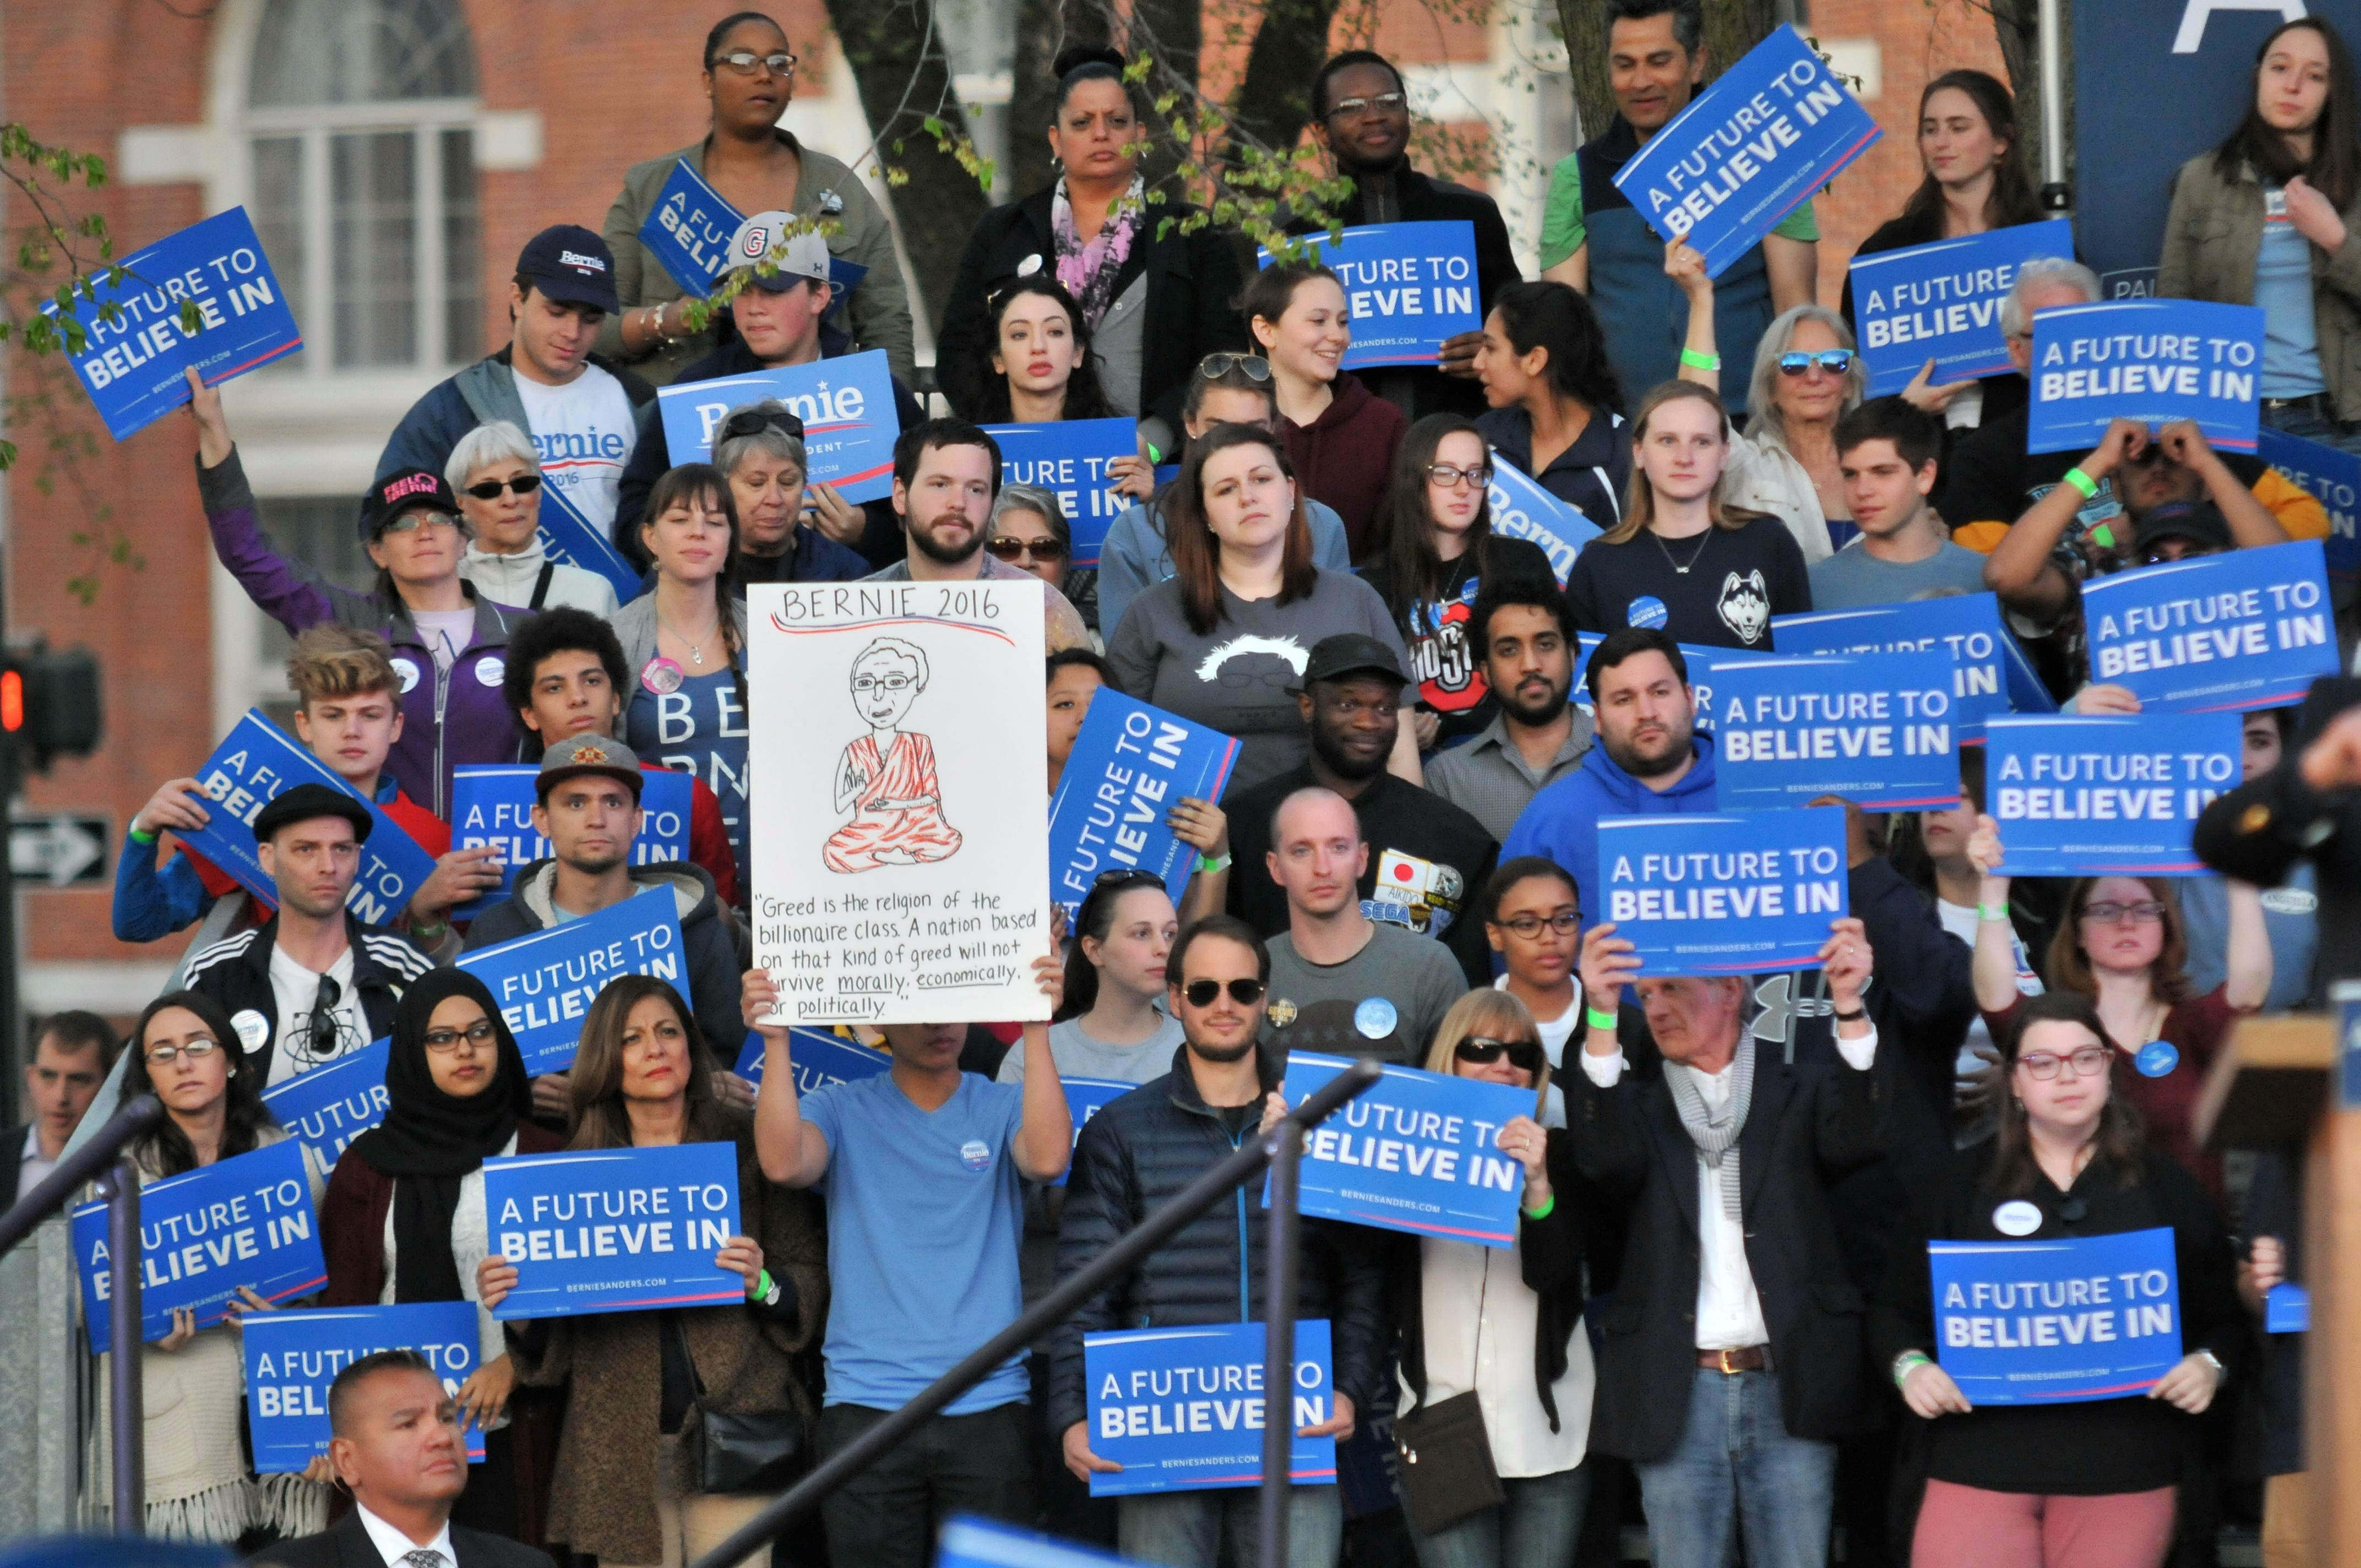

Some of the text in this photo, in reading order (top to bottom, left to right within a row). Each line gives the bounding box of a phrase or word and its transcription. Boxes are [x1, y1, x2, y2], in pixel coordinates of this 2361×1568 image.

[1649, 60, 1815, 213] A FUTURE TO
[1663, 81, 1842, 235] BELIEVE IN
[671, 192, 685, 211] A
[1740, 160, 1815, 224] BERNIESANDERS.COM
[659, 204, 719, 274] BELI
[743, 227, 769, 258] G
[562, 251, 605, 269] Bernie
[1336, 257, 1469, 288] TURE TO
[90, 248, 256, 344] FUTURE TO
[1434, 287, 1472, 313] IN
[1867, 290, 1886, 314] A
[1893, 265, 2016, 308] FUTURE
[84, 276, 274, 390] BELIEVE IN
[1347, 337, 1417, 349] IESANDERS.COM
[2043, 335, 2255, 367] A FUTURE TO
[2041, 365, 2252, 401] BELIEVE IN
[695, 380, 864, 444] Bnie
[532, 426, 624, 459] ernie
[384, 477, 416, 496] FEEL
[1001, 459, 1075, 485] TURE
[1091, 491, 1130, 516] IN
[2317, 477, 2355, 507] TO
[1488, 483, 1577, 580] Bern
[784, 587, 999, 620] BERNIE 2016
[2099, 581, 2319, 641] A FUTURE TO
[1944, 633, 1993, 661] TO
[2100, 615, 2325, 677] BELIEVE IN
[1955, 666, 1997, 697] IN
[658, 687, 749, 744] BE
[1727, 698, 1747, 723] A
[1755, 692, 1889, 722] FUTURE
[1898, 690, 1949, 717] TO
[1726, 725, 1949, 761] BELIEVE IN
[1999, 753, 2233, 782] A FUTURE TO
[1063, 763, 1133, 893] FUTURE
[1115, 711, 1151, 754] TO
[1109, 722, 1188, 867] IEVE IN
[1787, 782, 1884, 792] BERNIESANDERS.COM
[1998, 788, 2173, 819] BELIEVE
[223, 750, 404, 898] A TO
[465, 804, 485, 829] A
[641, 811, 681, 837] TO
[464, 837, 679, 866] BELI IN
[1612, 847, 1838, 882] A FUTURE TO
[345, 882, 387, 924] IN
[824, 900, 836, 912] is
[842, 894, 868, 912] the
[877, 893, 931, 920] religion
[944, 891, 960, 908] of
[972, 892, 1000, 909] the
[1359, 900, 1410, 923] SEGA
[1388, 887, 1419, 905] AIKIDO
[1611, 882, 1839, 921] BELIEVE IN
[760, 909, 1036, 944] billionaire class. A nation based
[503, 924, 671, 1001] FUTURE TO
[760, 955, 782, 970] on
[792, 950, 830, 968] that
[885, 944, 904, 964] of
[911, 944, 951, 971] greed
[959, 942, 986, 959] will
[993, 940, 1020, 956] not
[1675, 943, 1775, 953] BERNIESANDERS.COM
[773, 974, 824, 992] urvive
[501, 974, 635, 1034] ELIEV
[771, 1001, 786, 1015] or
[283, 1085, 390, 1139] FUTUR
[1346, 1101, 1464, 1144] UTURE
[1469, 1156, 1515, 1191] IN
[501, 1184, 727, 1224] A FUTURE TO
[1341, 1190, 1440, 1212] BERNIESANDERS.COM
[91, 1180, 301, 1265] A UTURE TO
[501, 1218, 731, 1262] BELIEVE IN
[93, 1211, 309, 1301] BLIEVE IN
[567, 1278, 666, 1292] BERNIESANDERS.COM
[1945, 1270, 2168, 1309] A FUTURE TO
[1945, 1304, 2171, 1347] BELIEVE IN
[258, 1353, 276, 1378] A
[421, 1343, 470, 1370] TO
[2007, 1369, 2109, 1381] BERNIESANDERS.COM
[1101, 1362, 1323, 1399] A FUTURE O
[1101, 1396, 1323, 1438] BELIEVE N
[1162, 1456, 1259, 1468] BERNIESANDERS.COM
